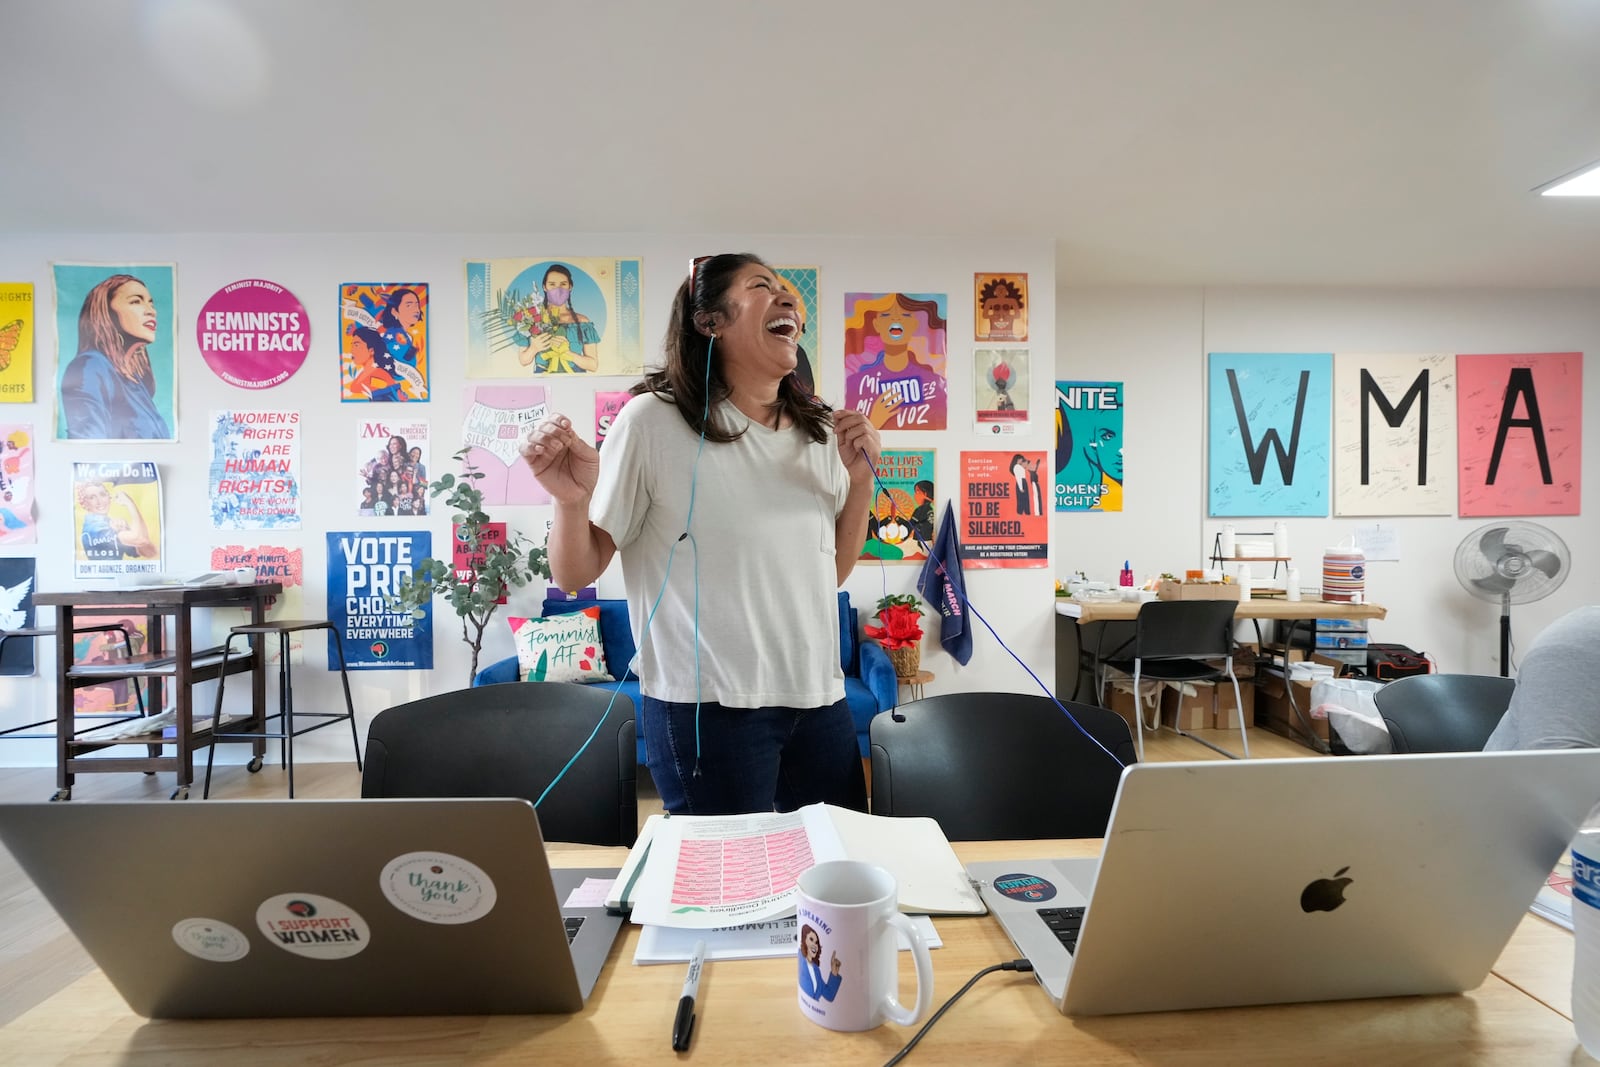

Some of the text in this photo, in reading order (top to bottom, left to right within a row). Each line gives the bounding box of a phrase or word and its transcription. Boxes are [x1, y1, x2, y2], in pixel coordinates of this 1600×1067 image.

[225, 281, 284, 294] FEMINIST MAJORITY
[205, 311, 301, 331] FEMINISTS
[203, 333, 305, 351] FIGHT BACK
[1055, 387, 1118, 409] NITE
[233, 413, 299, 423] WOMEN'S
[243, 429, 294, 439] RIGHTS
[362, 423, 391, 438] Ms
[1226, 368, 1553, 486] W M A
[262, 445, 291, 455] ARE
[225, 460, 291, 473] HUMAN
[878, 456, 923, 466] ACK LIVES
[77, 464, 98, 477] We
[100, 464, 120, 477] Can
[123, 465, 139, 477] Do
[218, 480, 293, 493] RIGHTS!
[969, 483, 1009, 497] REFUSE
[1056, 484, 1109, 495] OMEN'S
[968, 502, 1000, 516] TO BE
[476, 530, 500, 540] EEP
[968, 521, 1025, 535] SILENCED.
[341, 537, 413, 565] VOTE
[346, 565, 413, 596] PRO
[944, 583, 961, 616] MARCH
[346, 629, 414, 639] EVERYWHERE
[523, 624, 599, 651] Feminist
[552, 643, 581, 667] AF
[408, 871, 472, 893] thank
[997, 877, 1043, 889] WOMEN
[420, 887, 459, 905] you
[267, 917, 351, 931] I SUPPORT
[274, 928, 361, 944] WOMEN
